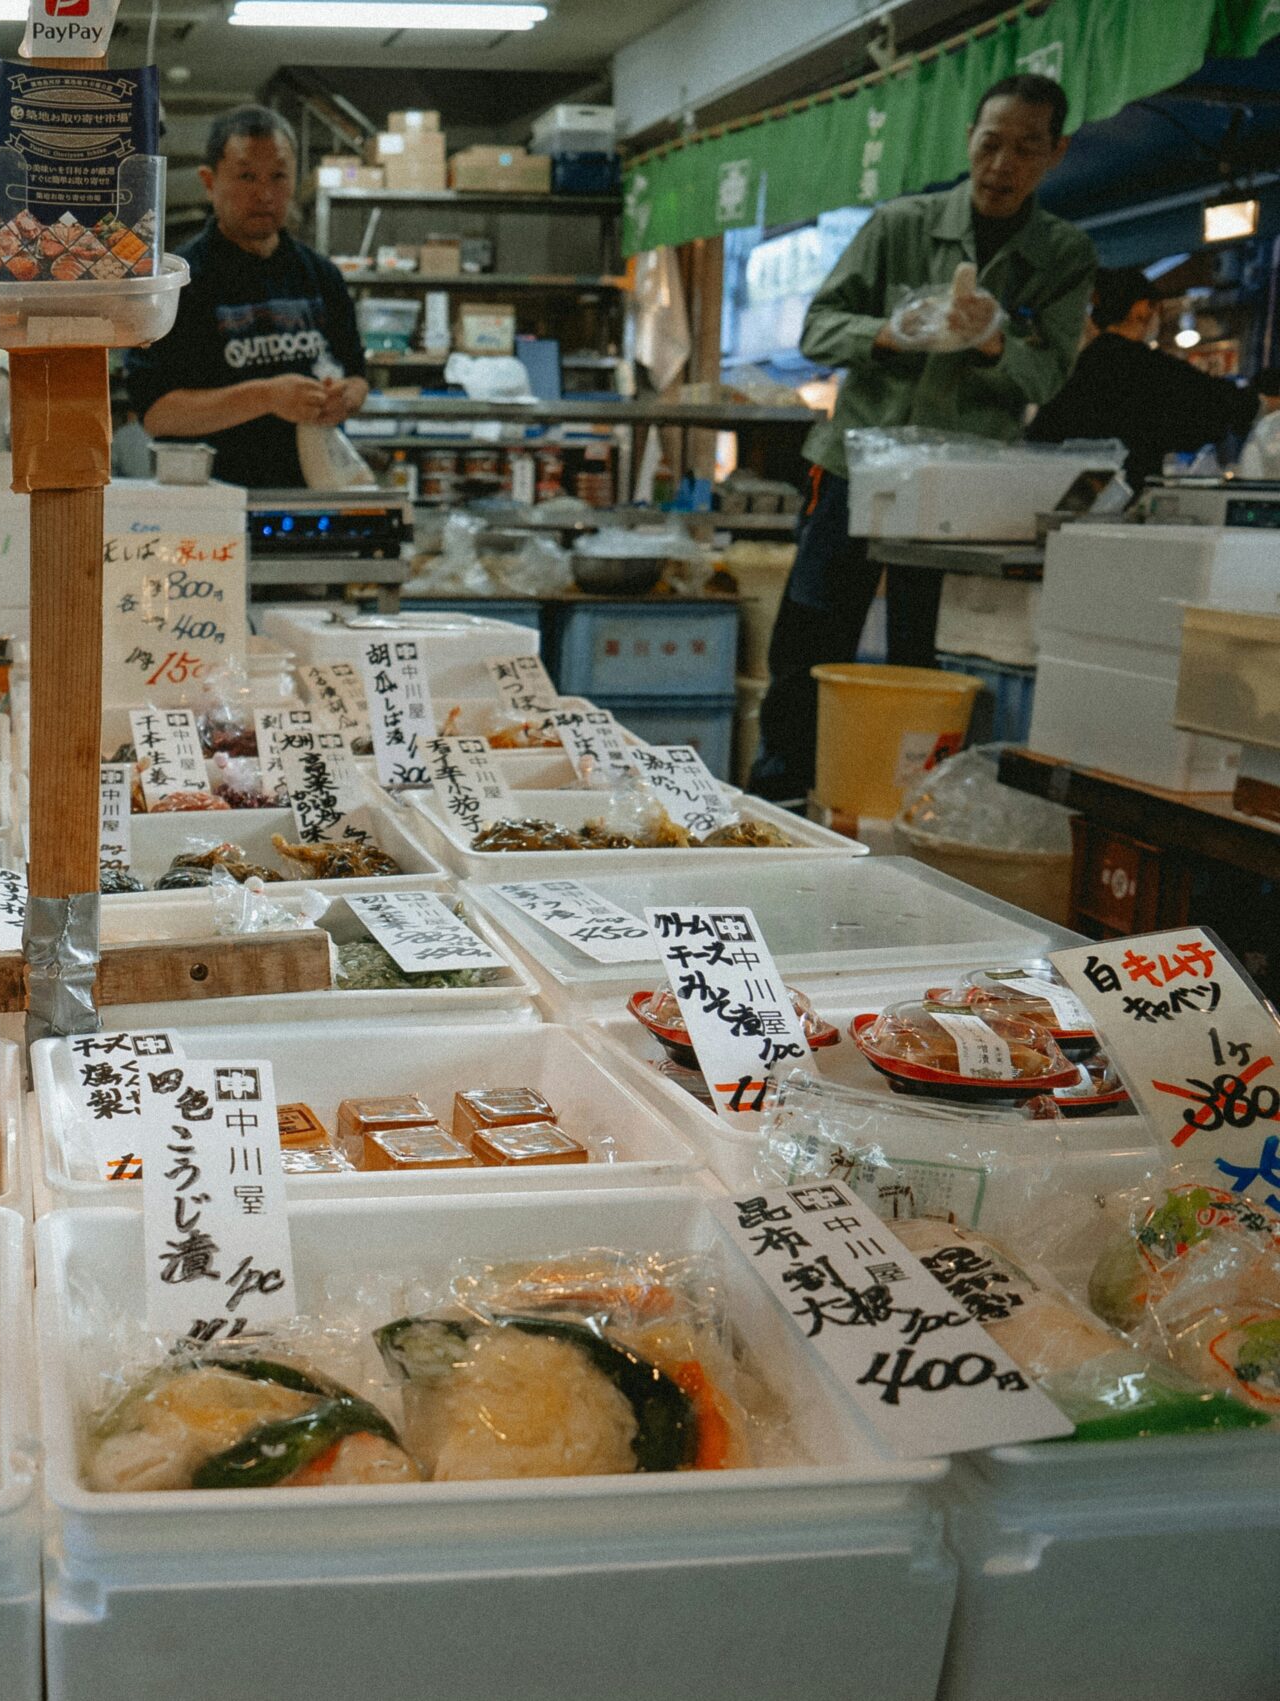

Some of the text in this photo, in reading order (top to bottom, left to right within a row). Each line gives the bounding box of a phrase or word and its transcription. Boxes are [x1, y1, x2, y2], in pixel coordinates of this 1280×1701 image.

[33, 23, 102, 42] PayPay
[25, 109, 129, 124] 築地お取り寄せ市場
[653, 911, 715, 938] クリーム
[666, 941, 734, 969] チーズ
[730, 946, 791, 1036] 中川屋
[1121, 981, 1222, 1024] キャベツ
[72, 1033, 132, 1057] チーズ
[147, 1068, 222, 1285] 四色こうじ漬
[225, 1108, 266, 1215] 中川屋
[822, 1215, 912, 1285] 中川屋
[855, 1348, 1030, 1406] 400円
